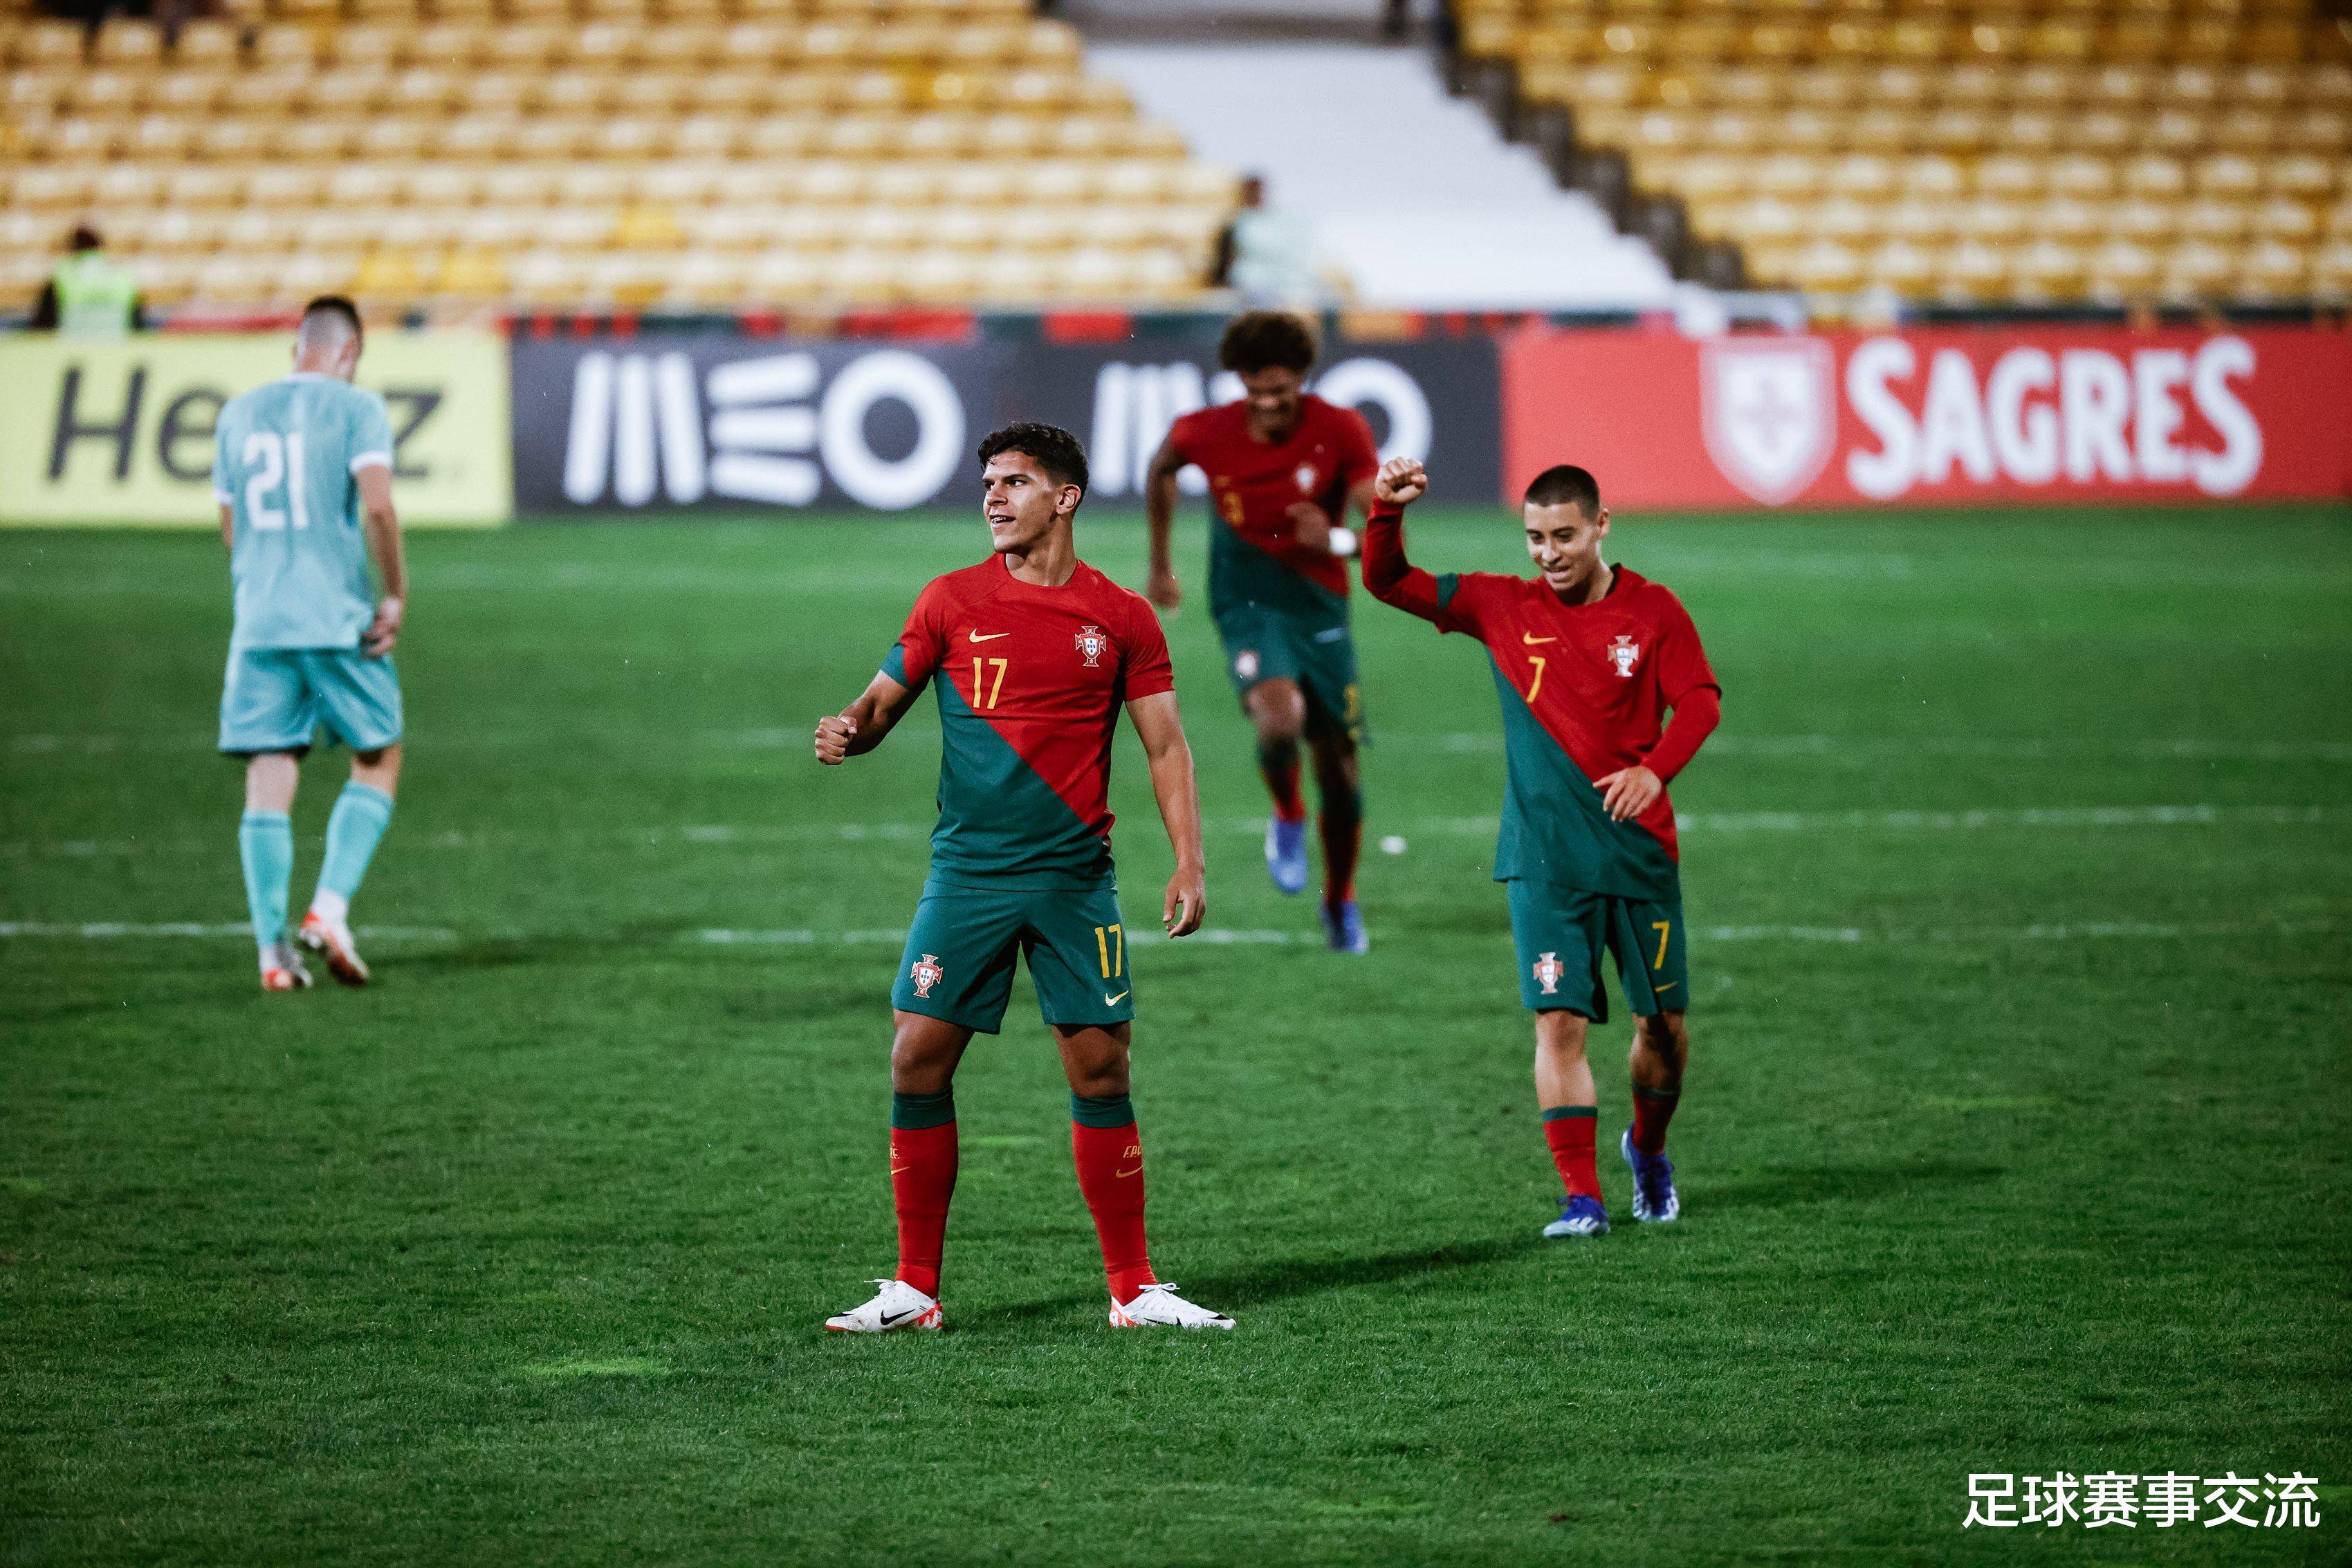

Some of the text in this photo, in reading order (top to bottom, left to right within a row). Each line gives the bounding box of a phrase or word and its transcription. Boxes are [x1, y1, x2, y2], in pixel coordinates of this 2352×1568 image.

[46, 365, 441, 483] Hez
[563, 346, 966, 510] MEO
[1090, 357, 1433, 495] MO
[1845, 335, 2263, 500] SAGRES
[242, 430, 309, 530] 21
[973, 656, 1008, 710] 17
[1527, 656, 1546, 703] 7
[1094, 923, 1122, 979] 17
[1651, 921, 1669, 970] 7
